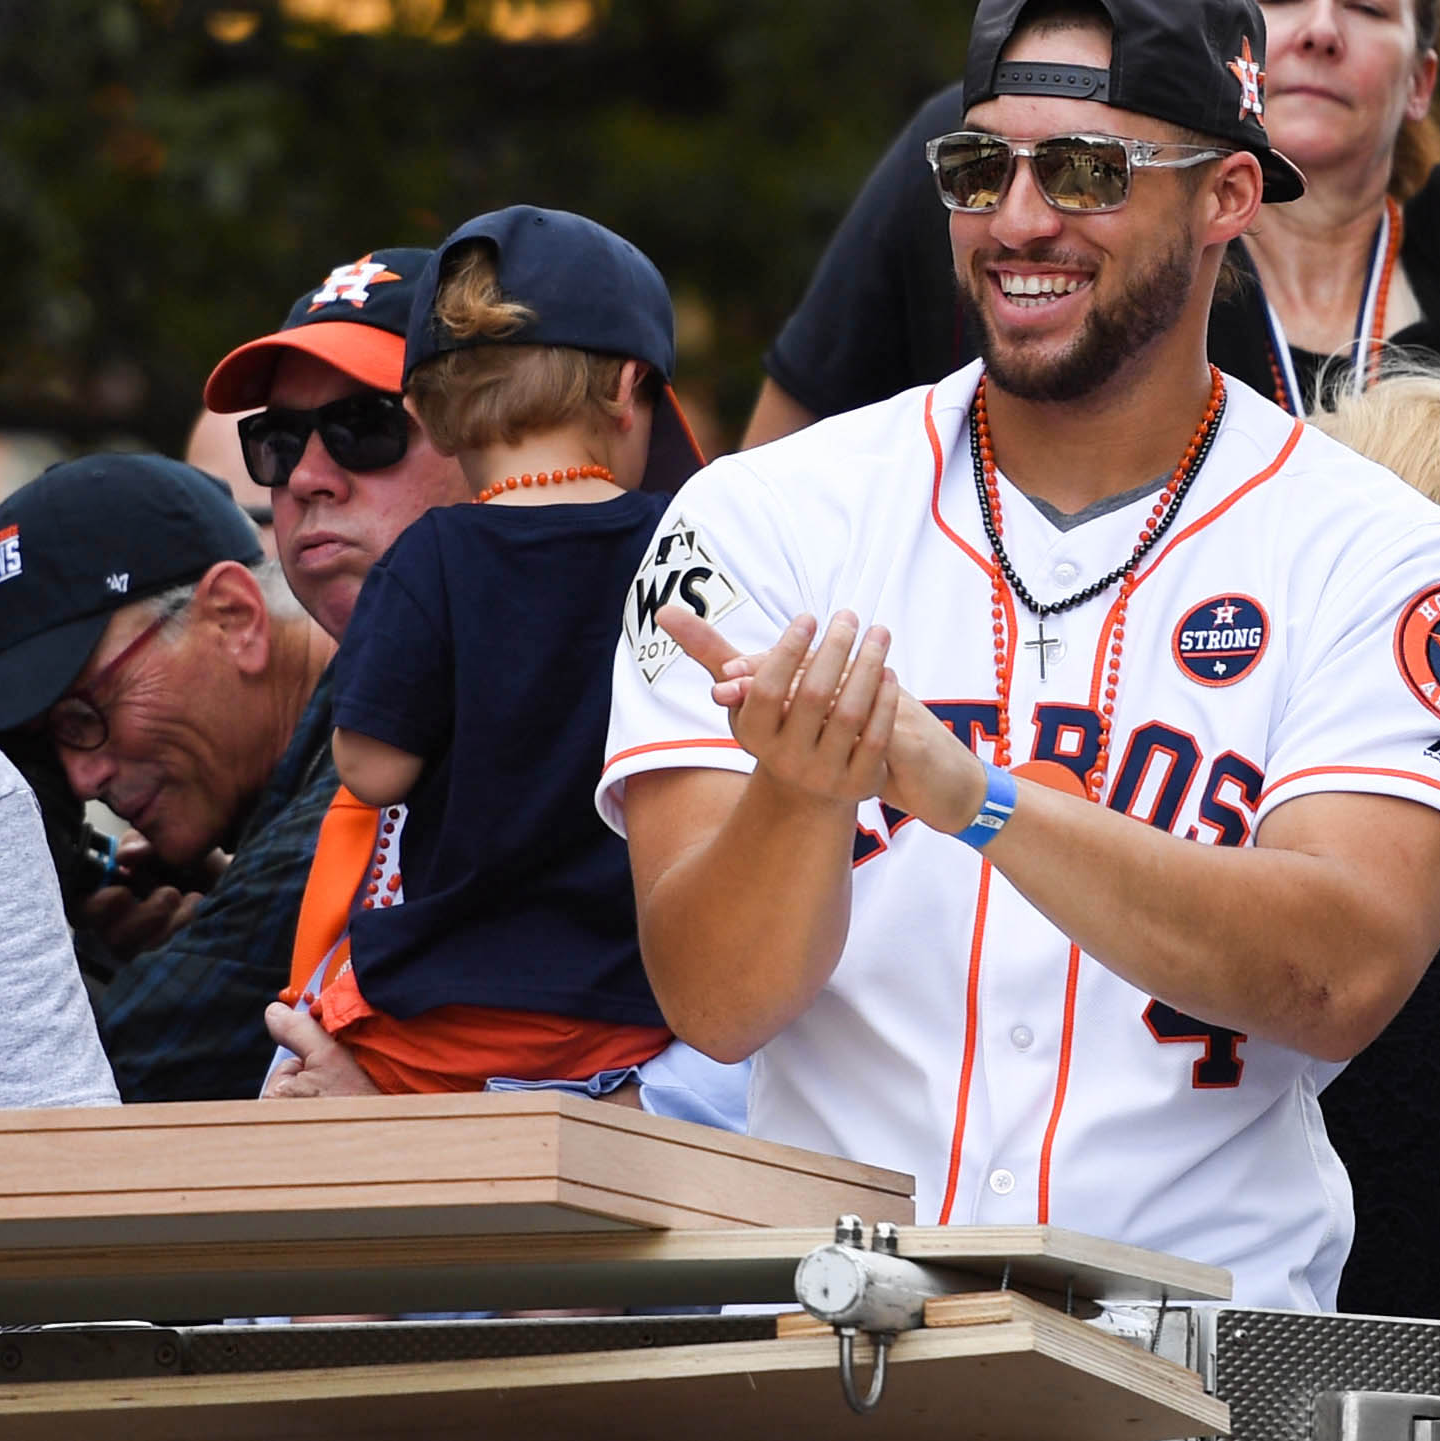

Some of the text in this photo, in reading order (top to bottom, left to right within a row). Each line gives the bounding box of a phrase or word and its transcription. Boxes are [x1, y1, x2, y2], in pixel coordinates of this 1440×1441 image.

[312, 263, 388, 304] H
[636, 566, 714, 637] WS
[1214, 606, 1235, 624] H
[638, 639, 680, 662] 2017
[1180, 627, 1262, 651] STRONG
[853, 699, 1265, 868] TROS
